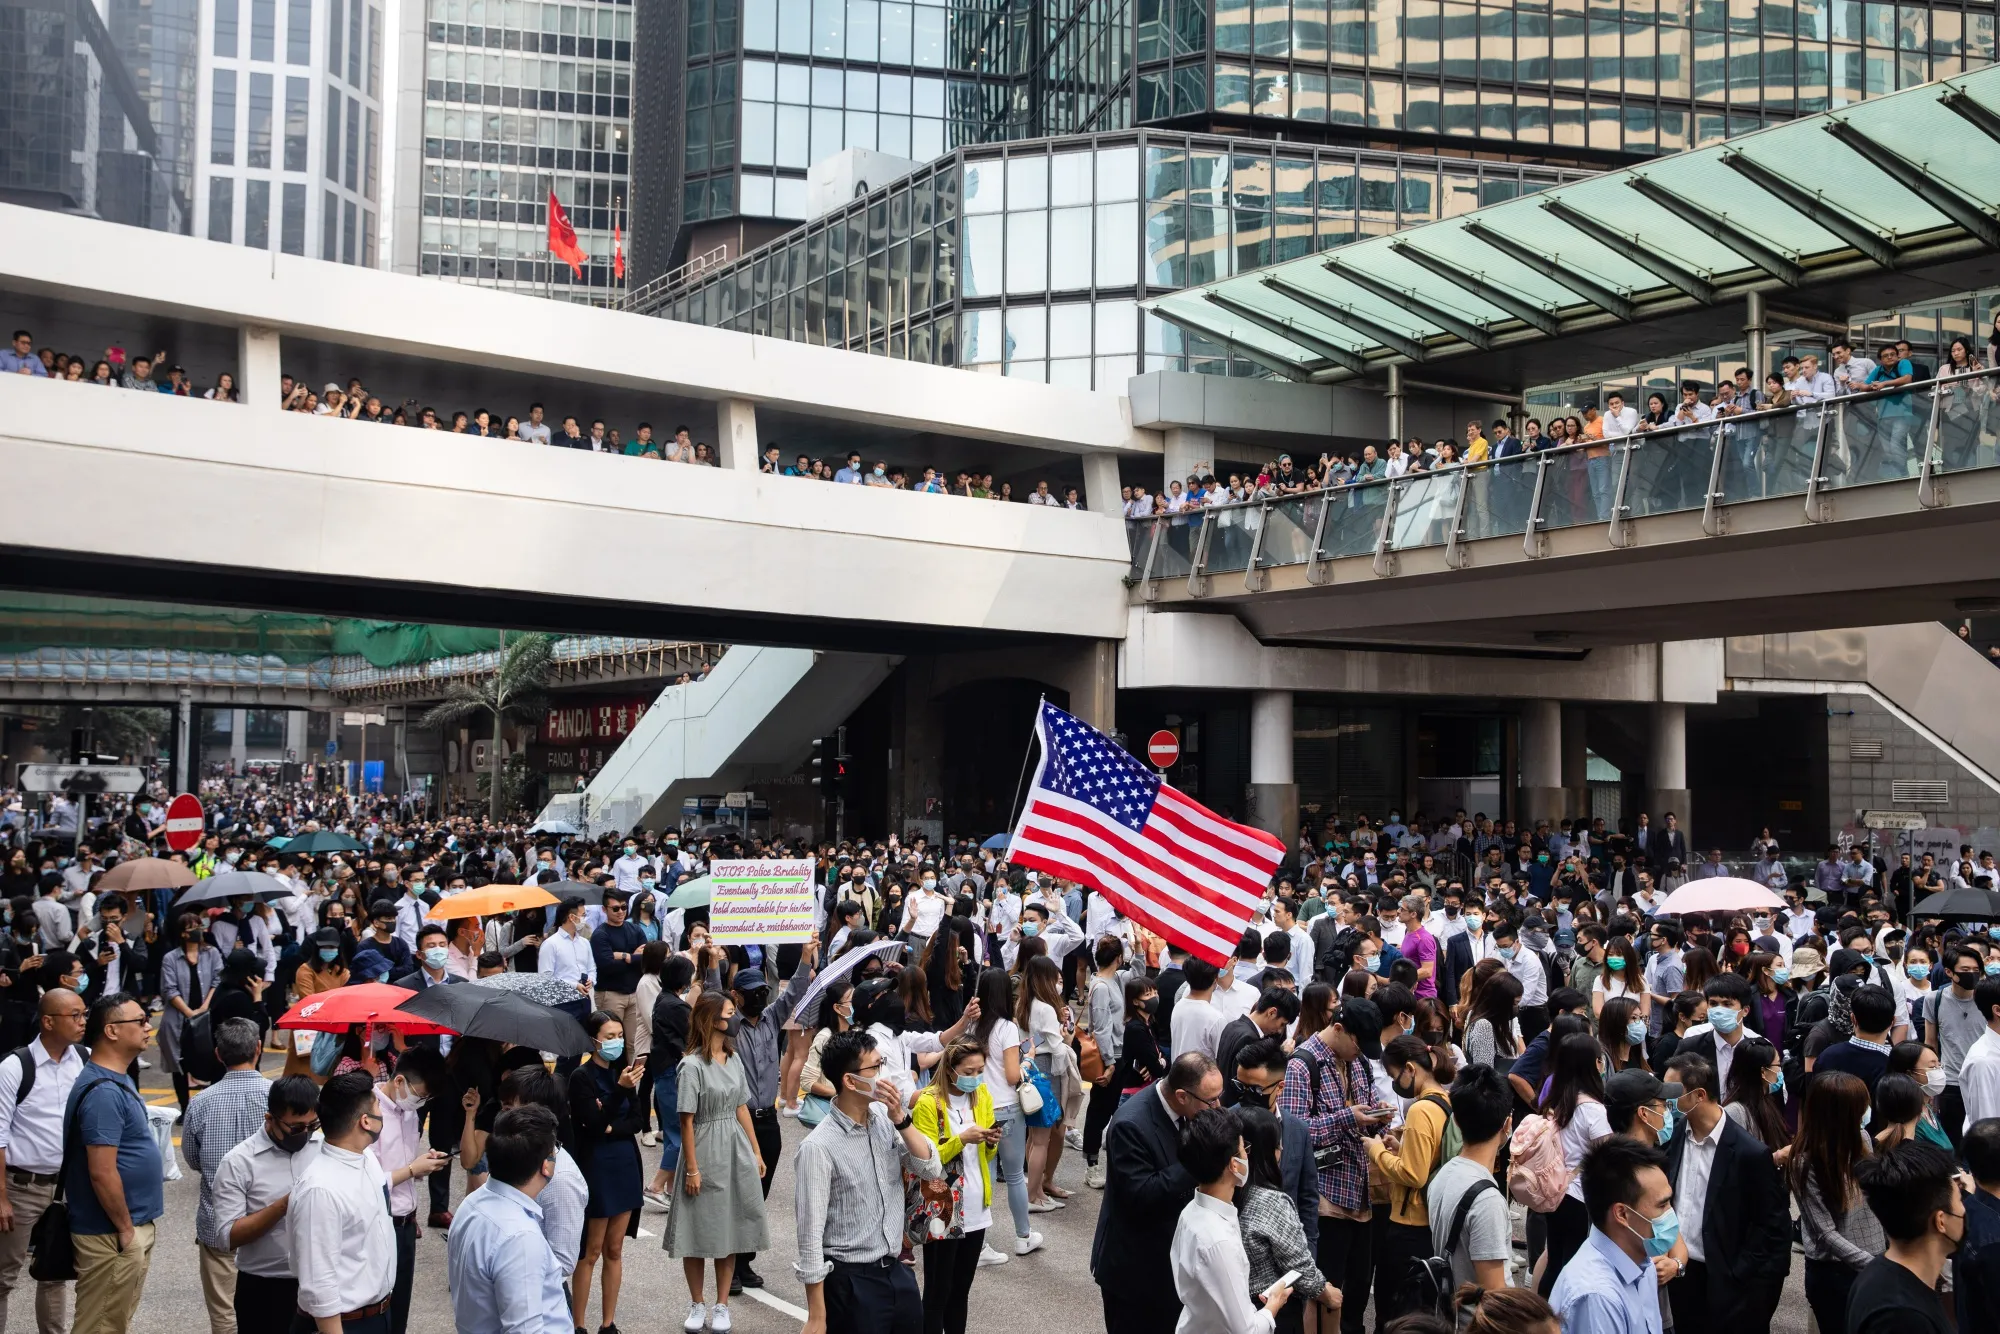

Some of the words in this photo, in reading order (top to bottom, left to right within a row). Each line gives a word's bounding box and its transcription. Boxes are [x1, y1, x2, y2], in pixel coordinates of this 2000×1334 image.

[549, 708, 592, 737] FANDA
[547, 752, 574, 768] FANDA
[1927, 839, 1953, 856] people
[714, 866, 745, 877] STOP
[746, 864, 771, 877] Police
[773, 864, 812, 881] Brutality
[717, 883, 758, 900] Eventually
[761, 883, 784, 895] Police
[784, 882, 799, 894] will
[799, 882, 809, 894] be
[712, 902, 731, 914] held
[730, 901, 775, 914] accountable
[775, 901, 788, 915] for
[789, 902, 812, 913] his/her
[712, 920, 755, 932] misconduct
[756, 923, 765, 933] &
[767, 919, 812, 931] misbehavior
